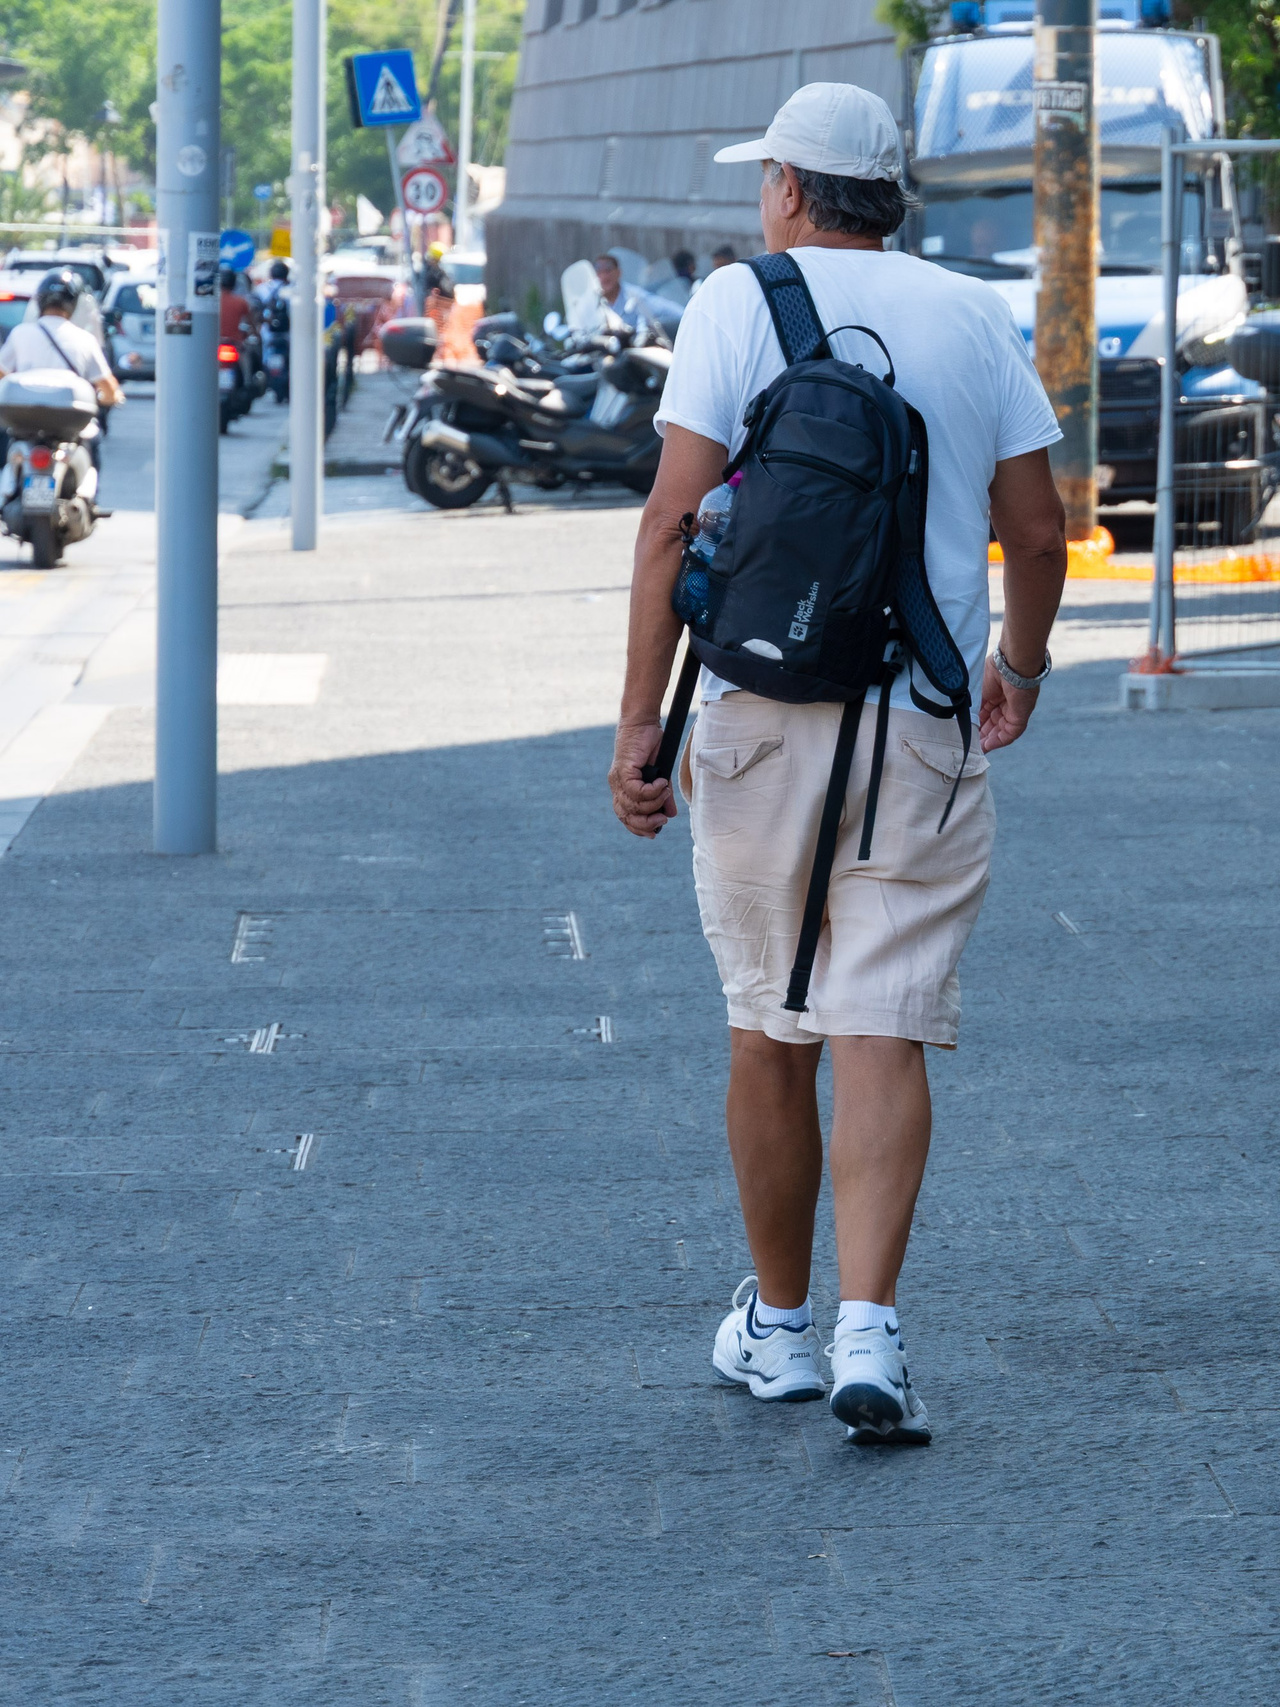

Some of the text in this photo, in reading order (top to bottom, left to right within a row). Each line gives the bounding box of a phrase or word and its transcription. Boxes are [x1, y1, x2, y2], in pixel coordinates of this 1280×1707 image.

[411, 181, 436, 202] 30
[793, 599, 807, 623] Jack
[800, 581, 820, 623] Wolfskin
